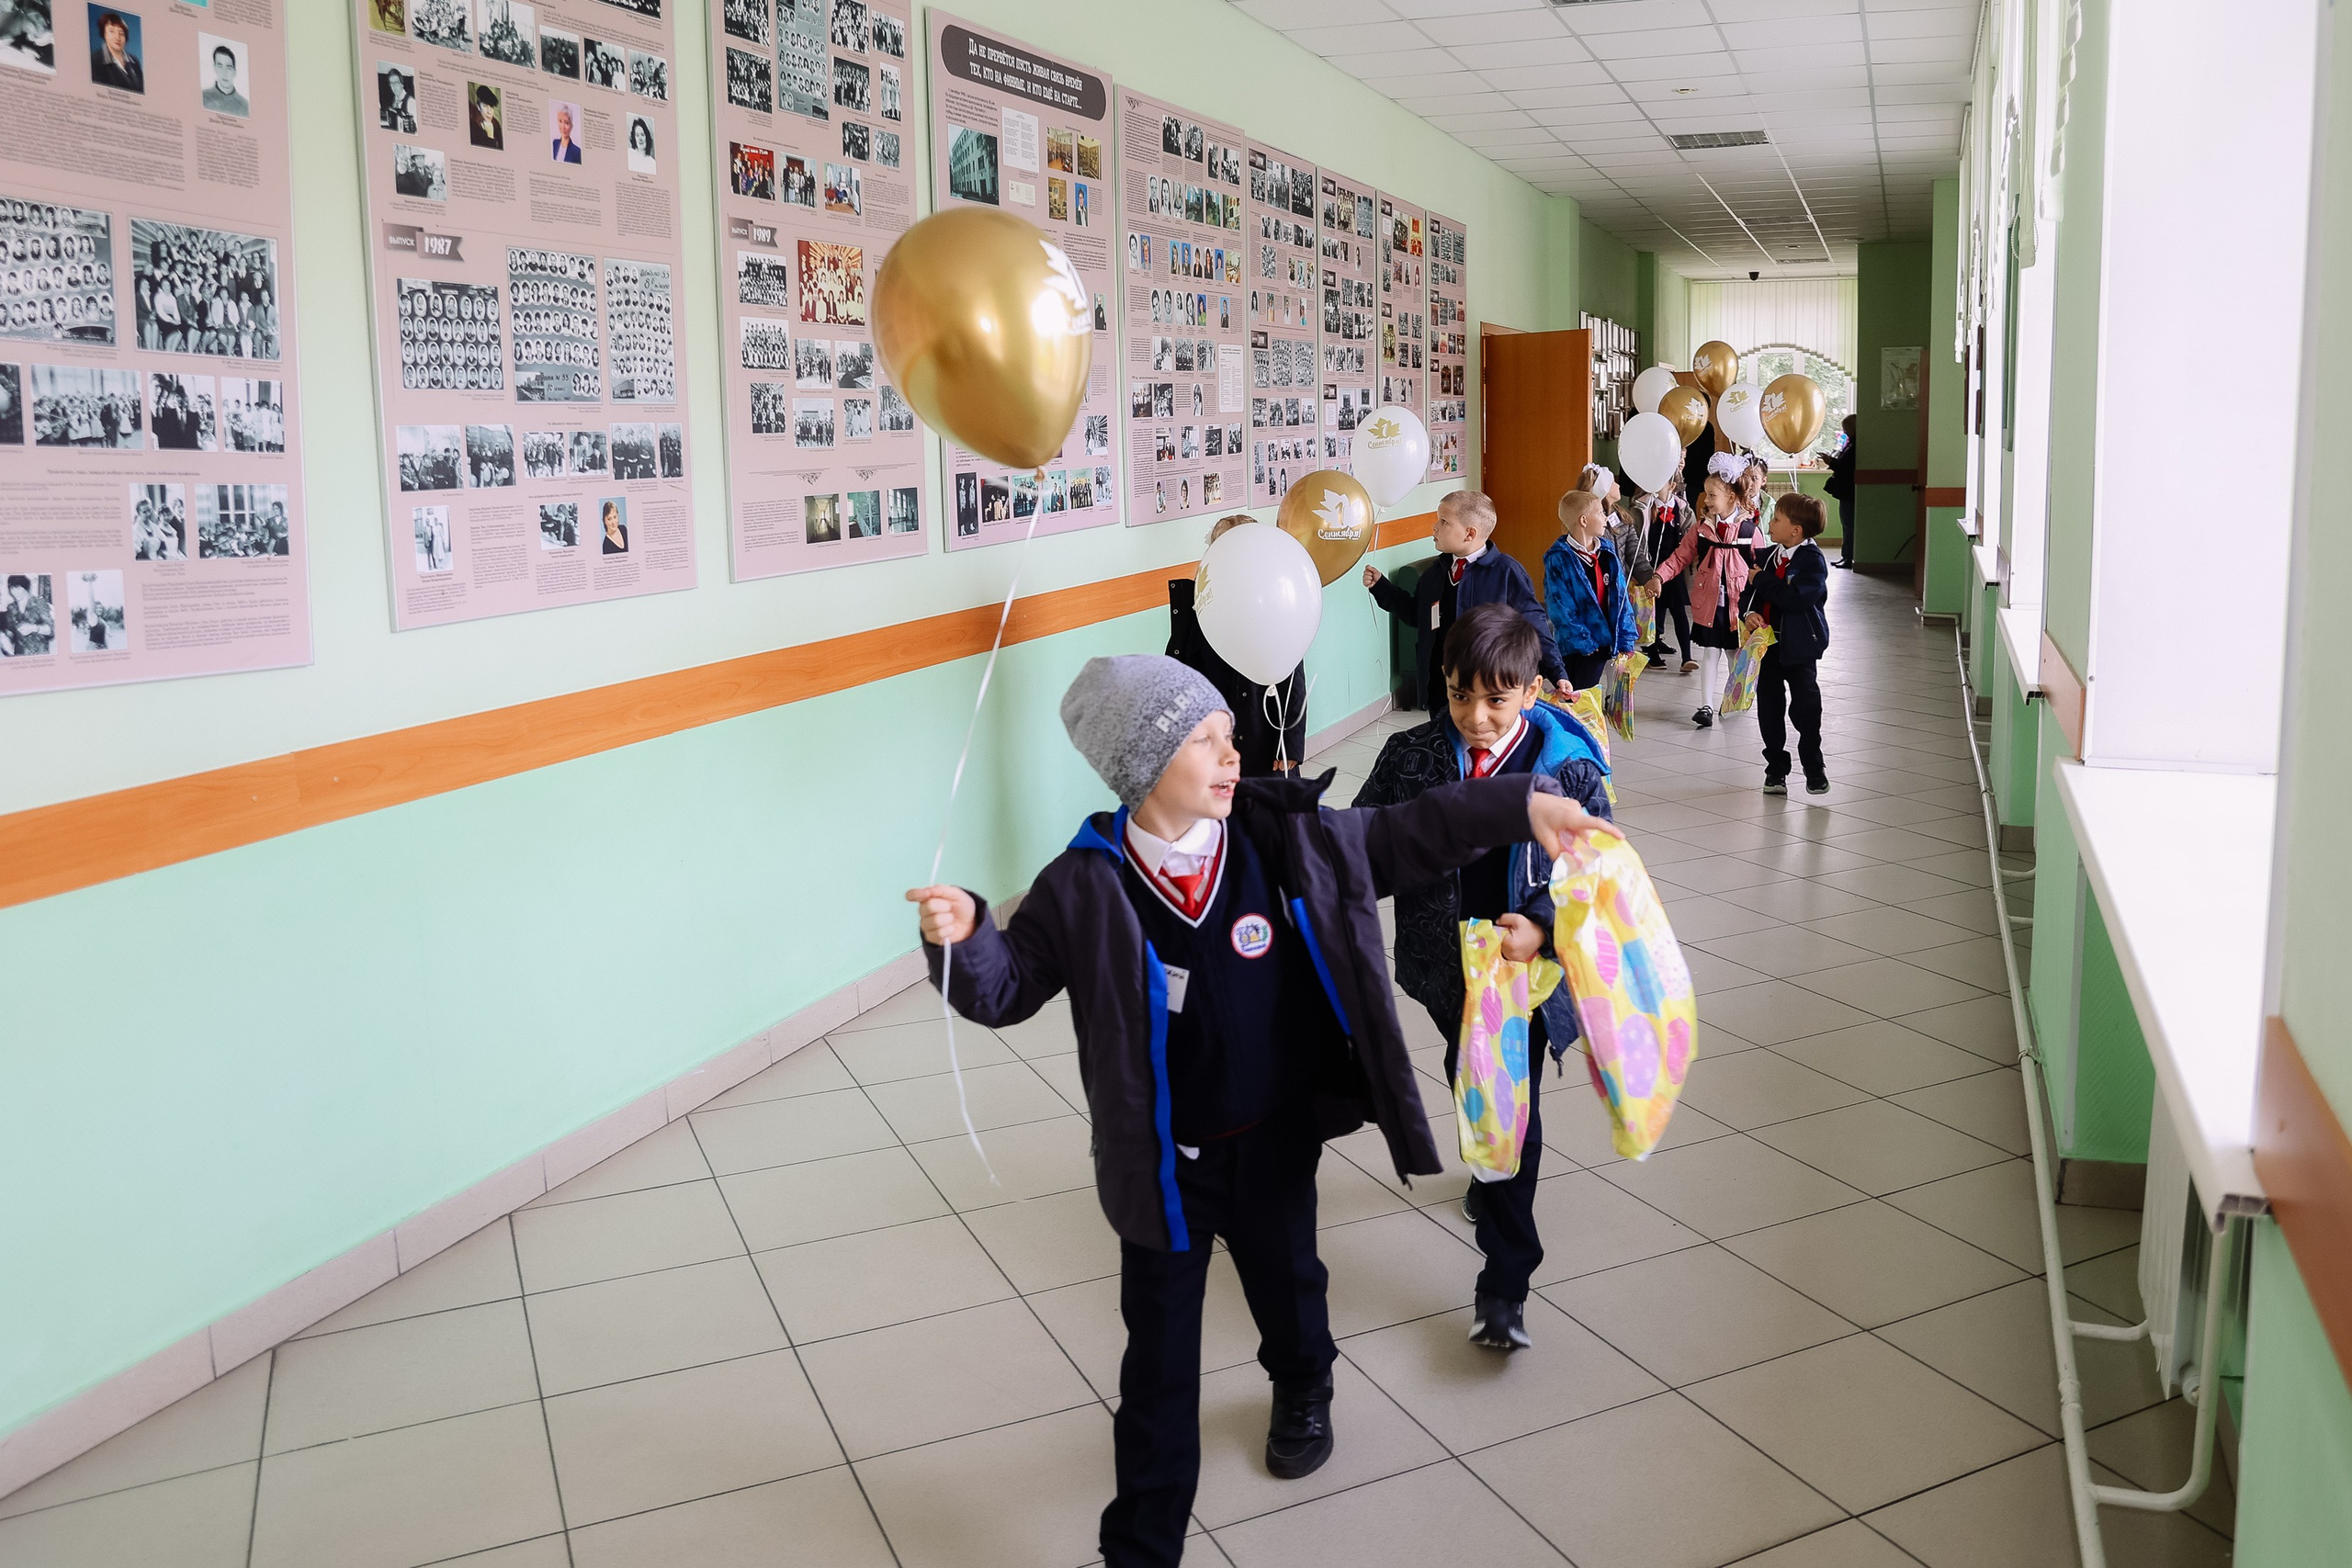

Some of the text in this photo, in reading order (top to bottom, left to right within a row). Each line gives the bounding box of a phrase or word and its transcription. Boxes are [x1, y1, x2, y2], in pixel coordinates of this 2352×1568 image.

[978, 44, 987, 59] НЕ
[969, 62, 982, 78] ТЕХ,
[982, 65, 994, 82] КТО
[994, 70, 1002, 85] НА
[1026, 80, 1032, 94] И
[1032, 82, 1042, 96] КТО
[1054, 89, 1061, 103] НА
[753, 227, 772, 243] 1989
[389, 235, 452, 255] ВЫПУСК 1987
[1317, 527, 1363, 540] Сентября!
